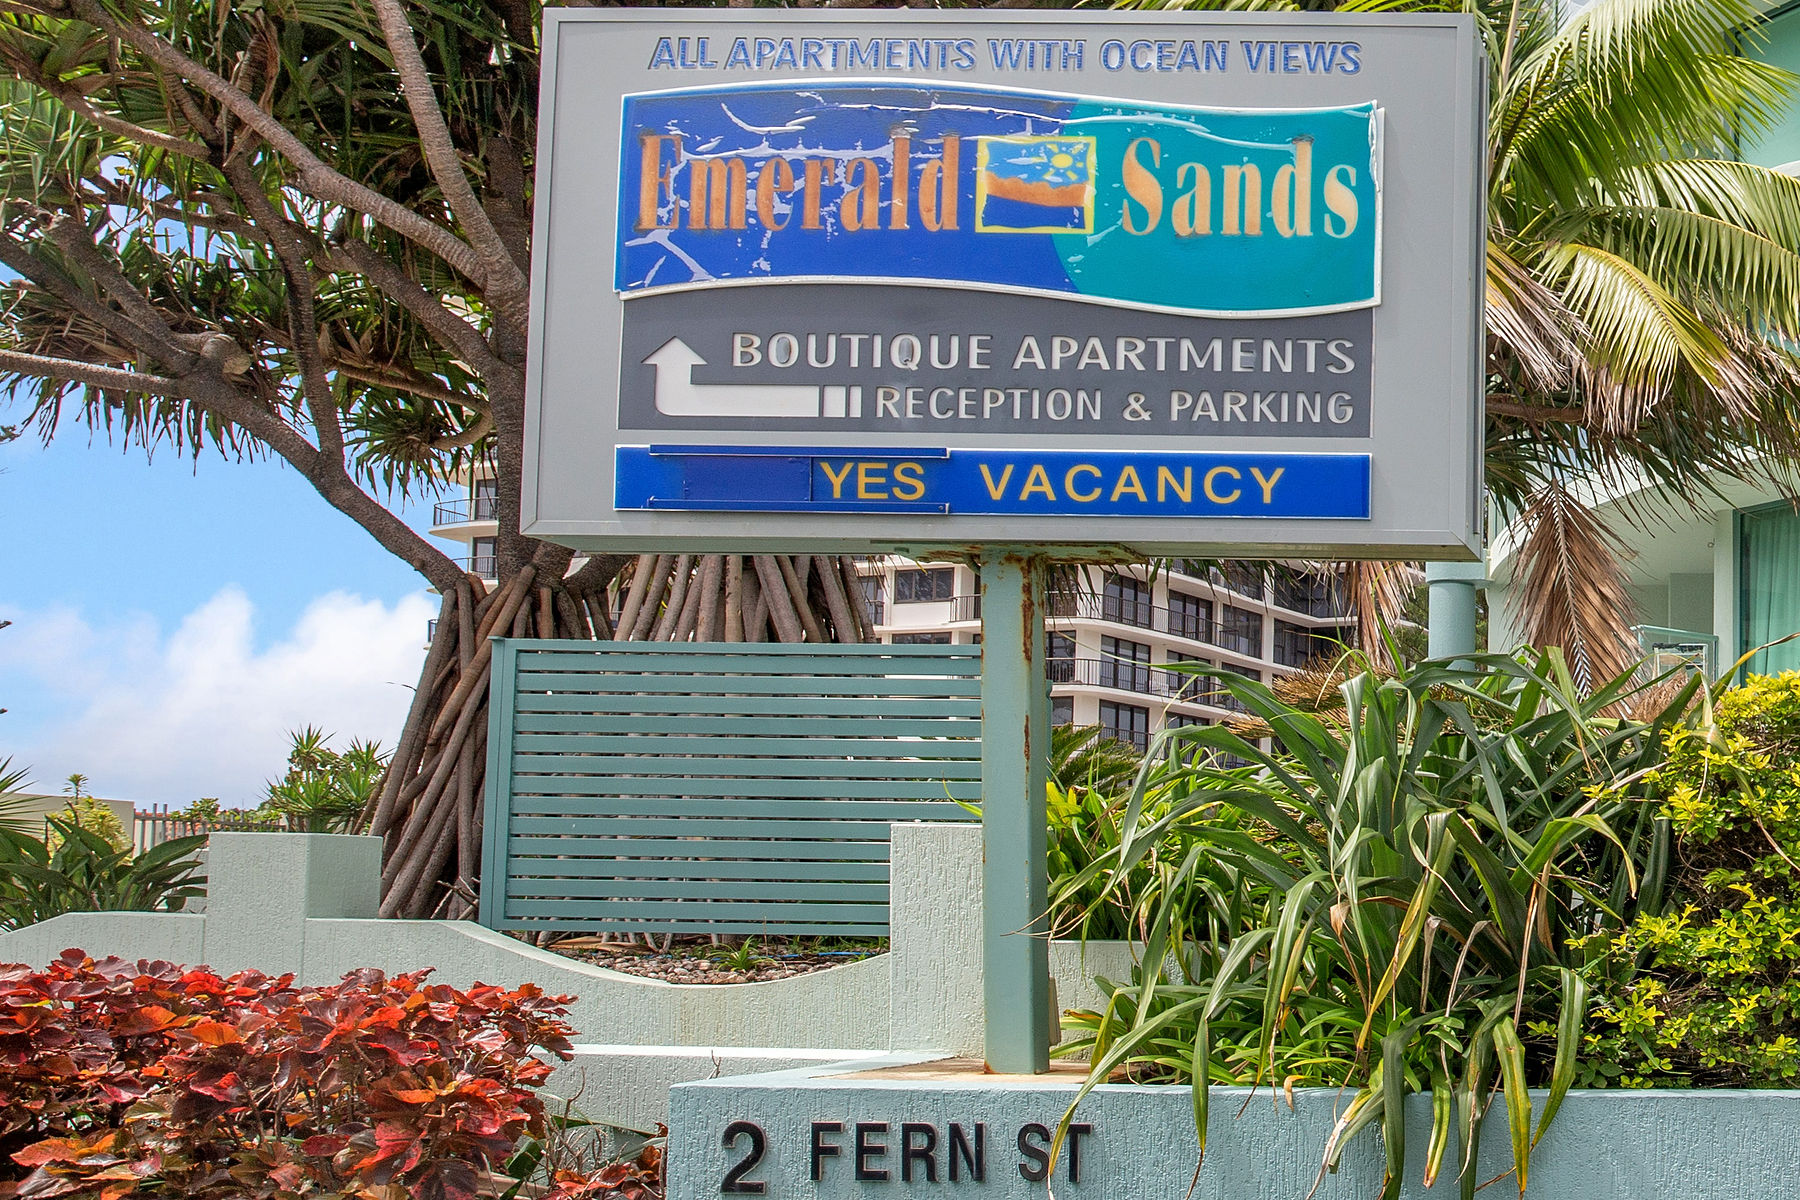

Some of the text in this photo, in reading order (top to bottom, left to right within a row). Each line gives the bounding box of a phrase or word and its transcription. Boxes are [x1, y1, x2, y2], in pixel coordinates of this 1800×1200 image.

[648, 37, 1363, 75] ALL APARTMENTS WITH OCEAN VIEWS
[635, 125, 1360, 239] Emerald Sands
[730, 333, 1357, 374] BOUTIQUE APARTMENTS
[874, 386, 1354, 425] RECEPTION & PARKING
[819, 461, 1285, 505] YES VACANCY
[720, 1120, 1093, 1194] 2 FERN ST
